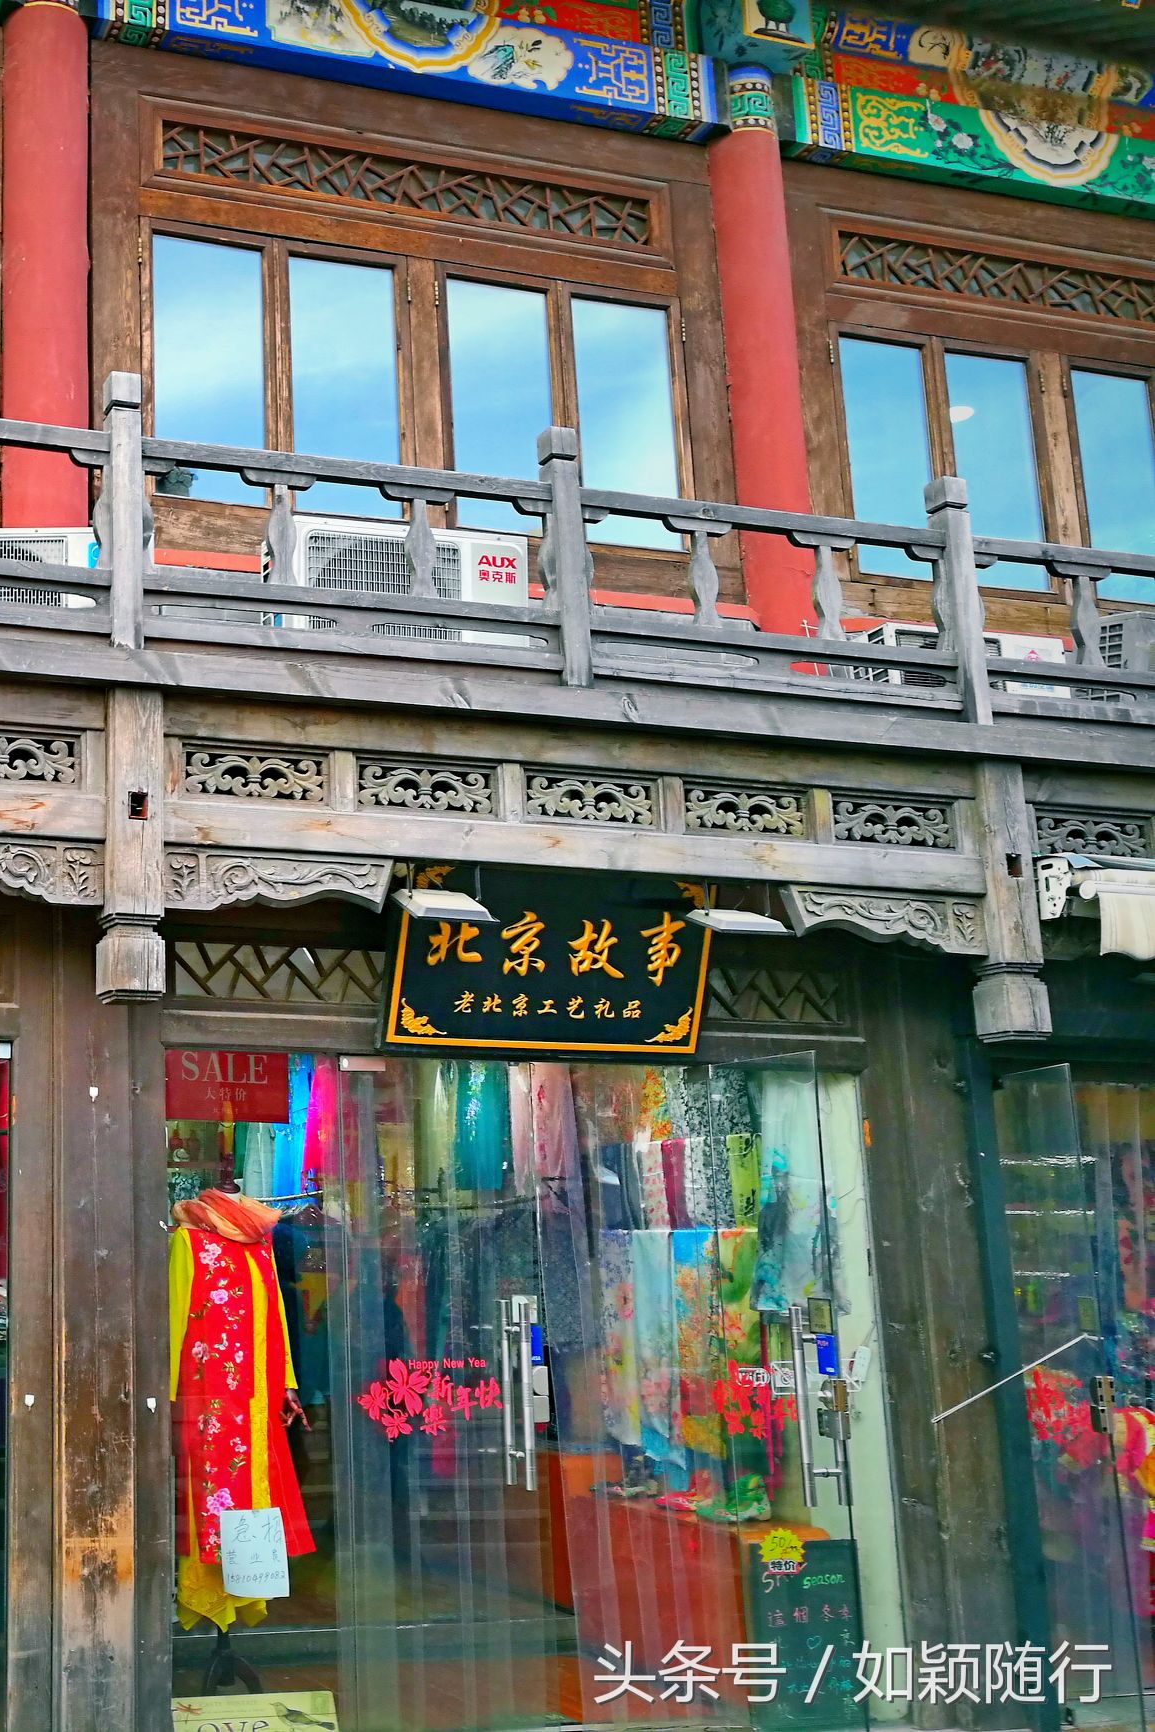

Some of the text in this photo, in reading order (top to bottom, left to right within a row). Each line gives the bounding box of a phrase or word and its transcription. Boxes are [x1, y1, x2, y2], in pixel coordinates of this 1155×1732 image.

[478, 555, 517, 570] AUX
[479, 569, 517, 585] 奥克斯
[426, 910, 687, 988] 北京故事
[453, 990, 642, 1020] 老北京工艺礼品
[181, 1051, 268, 1084] SALE
[408, 1357, 486, 1372] Happy New Yea
[232, 1514, 283, 1543] 急招
[770, 1560, 797, 1571] 特价
[803, 1573, 846, 1589] season
